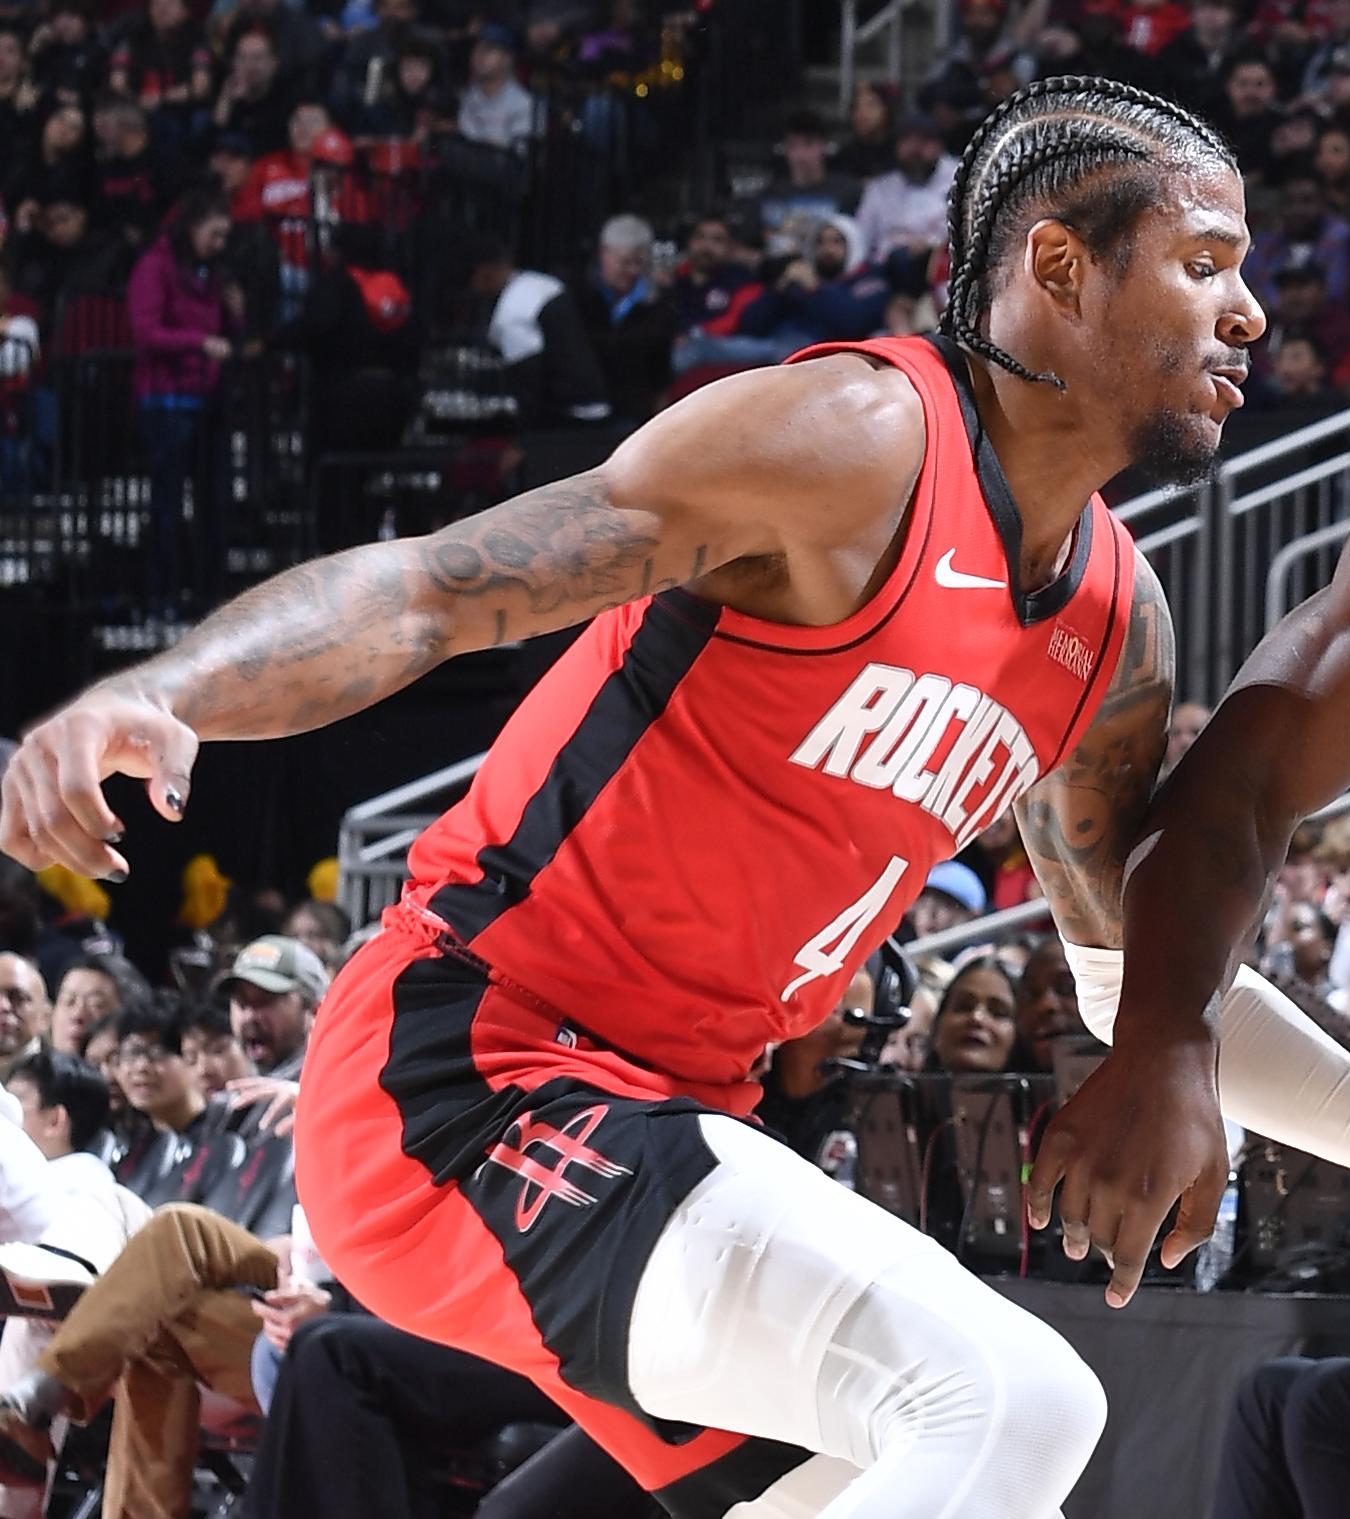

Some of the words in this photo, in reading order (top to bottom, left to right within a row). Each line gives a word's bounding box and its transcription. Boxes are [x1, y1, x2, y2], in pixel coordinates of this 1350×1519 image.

[1047, 639, 1092, 682] HERMANN
[1051, 627, 1094, 669] MEMORIAL
[780, 855, 909, 1003] 4
